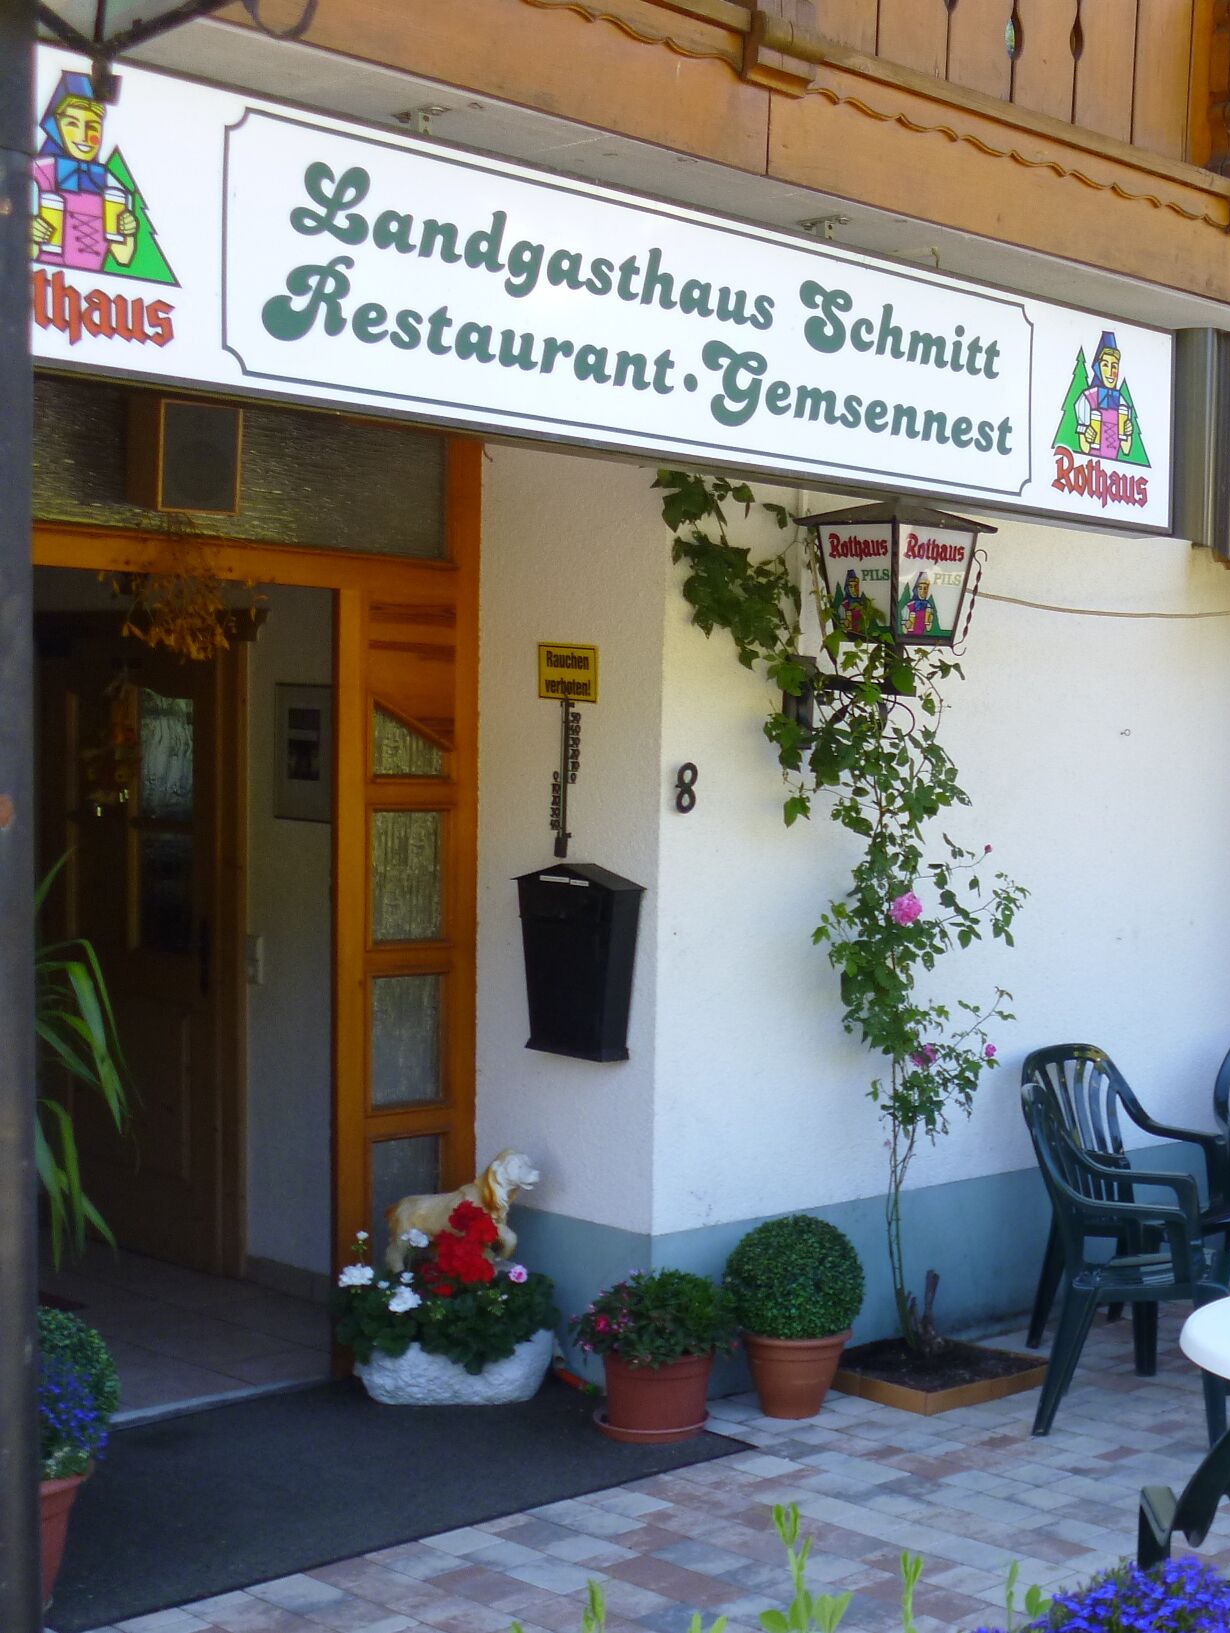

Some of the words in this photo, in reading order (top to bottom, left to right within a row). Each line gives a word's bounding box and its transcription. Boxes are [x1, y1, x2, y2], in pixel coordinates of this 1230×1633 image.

[289, 161, 775, 330] Landgasthaus
[799, 279, 1001, 380] Schmitt
[32, 268, 176, 348] thaus
[701, 339, 1013, 456] Gemsennest
[1051, 446, 1149, 509] Rothaus
[828, 532, 888, 561] Rothaus
[903, 532, 966, 564] Rothaus
[861, 568, 890, 582] PILS
[933, 572, 963, 586] PILS
[546, 650, 590, 671] Rauchen
[544, 677, 591, 697] verboten!
[675, 761, 699, 815] 8
